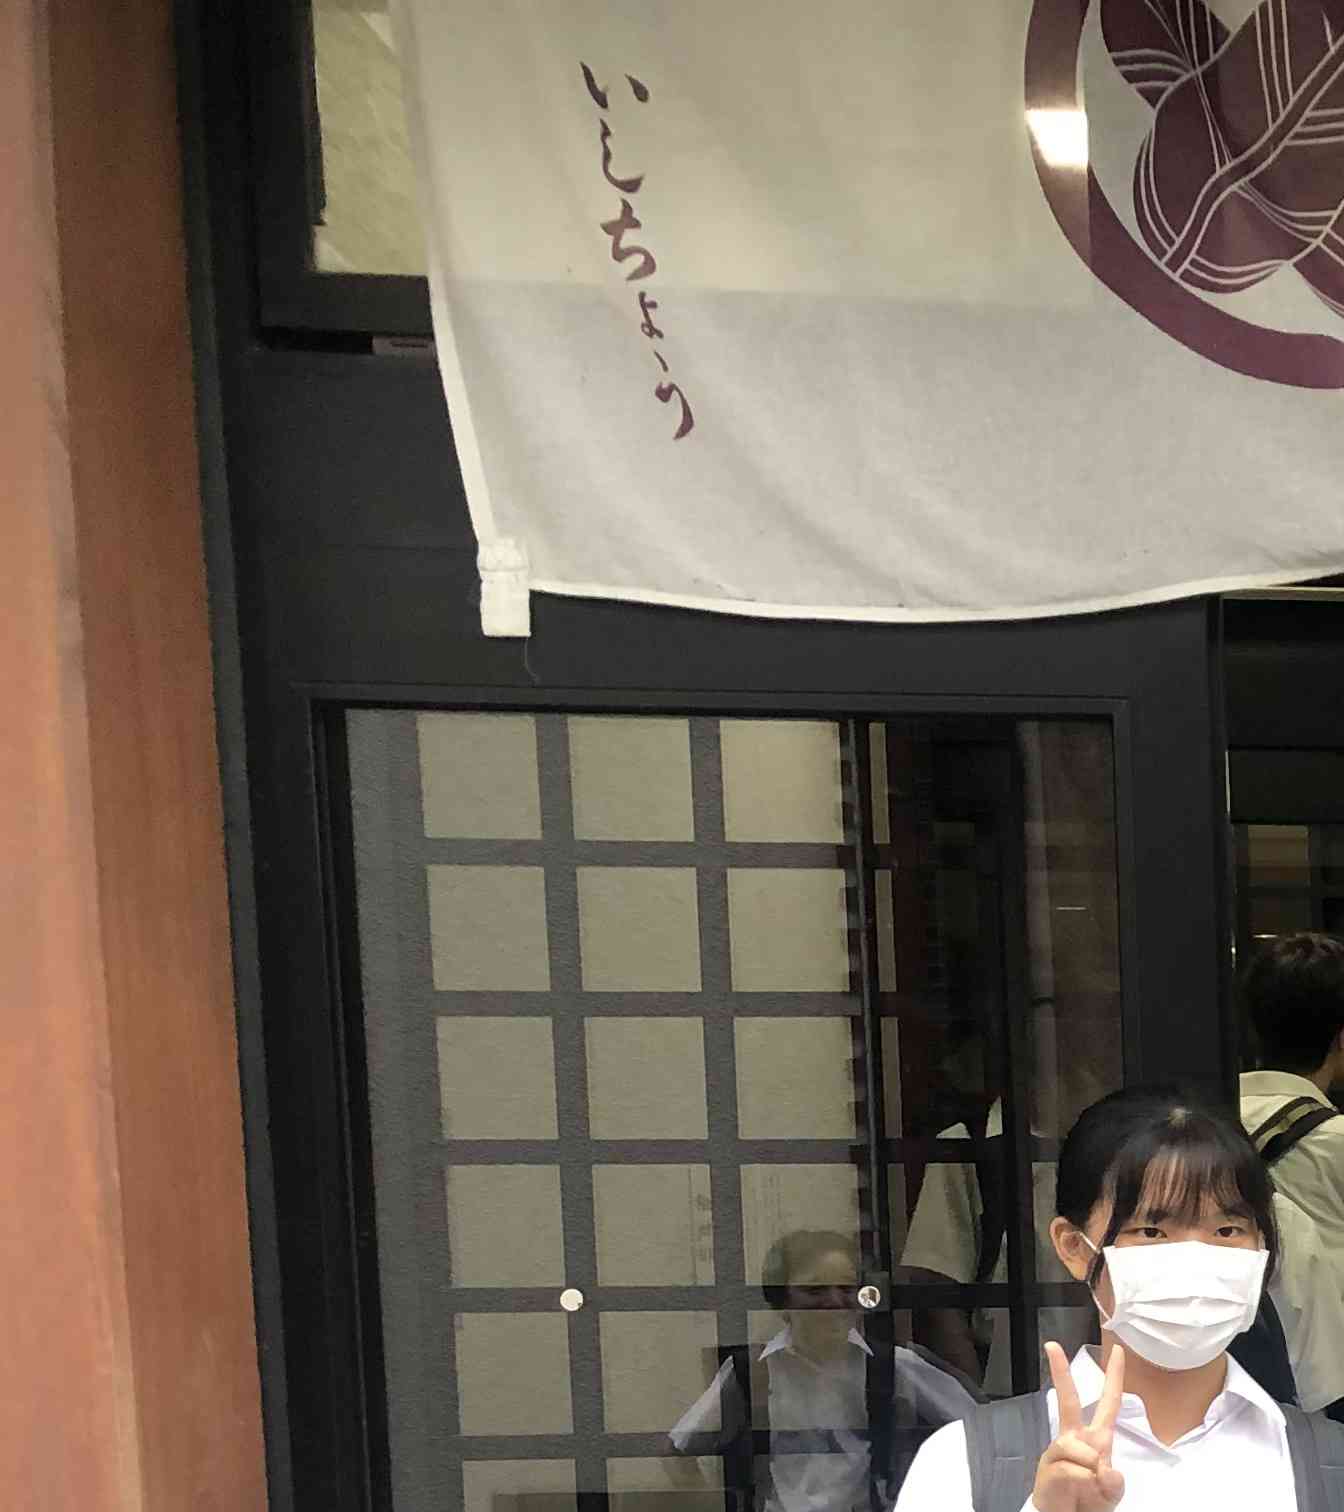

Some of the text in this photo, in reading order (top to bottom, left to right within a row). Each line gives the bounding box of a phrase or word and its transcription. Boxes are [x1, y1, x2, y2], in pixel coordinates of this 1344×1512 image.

[580, 61, 695, 441] いしちょう
